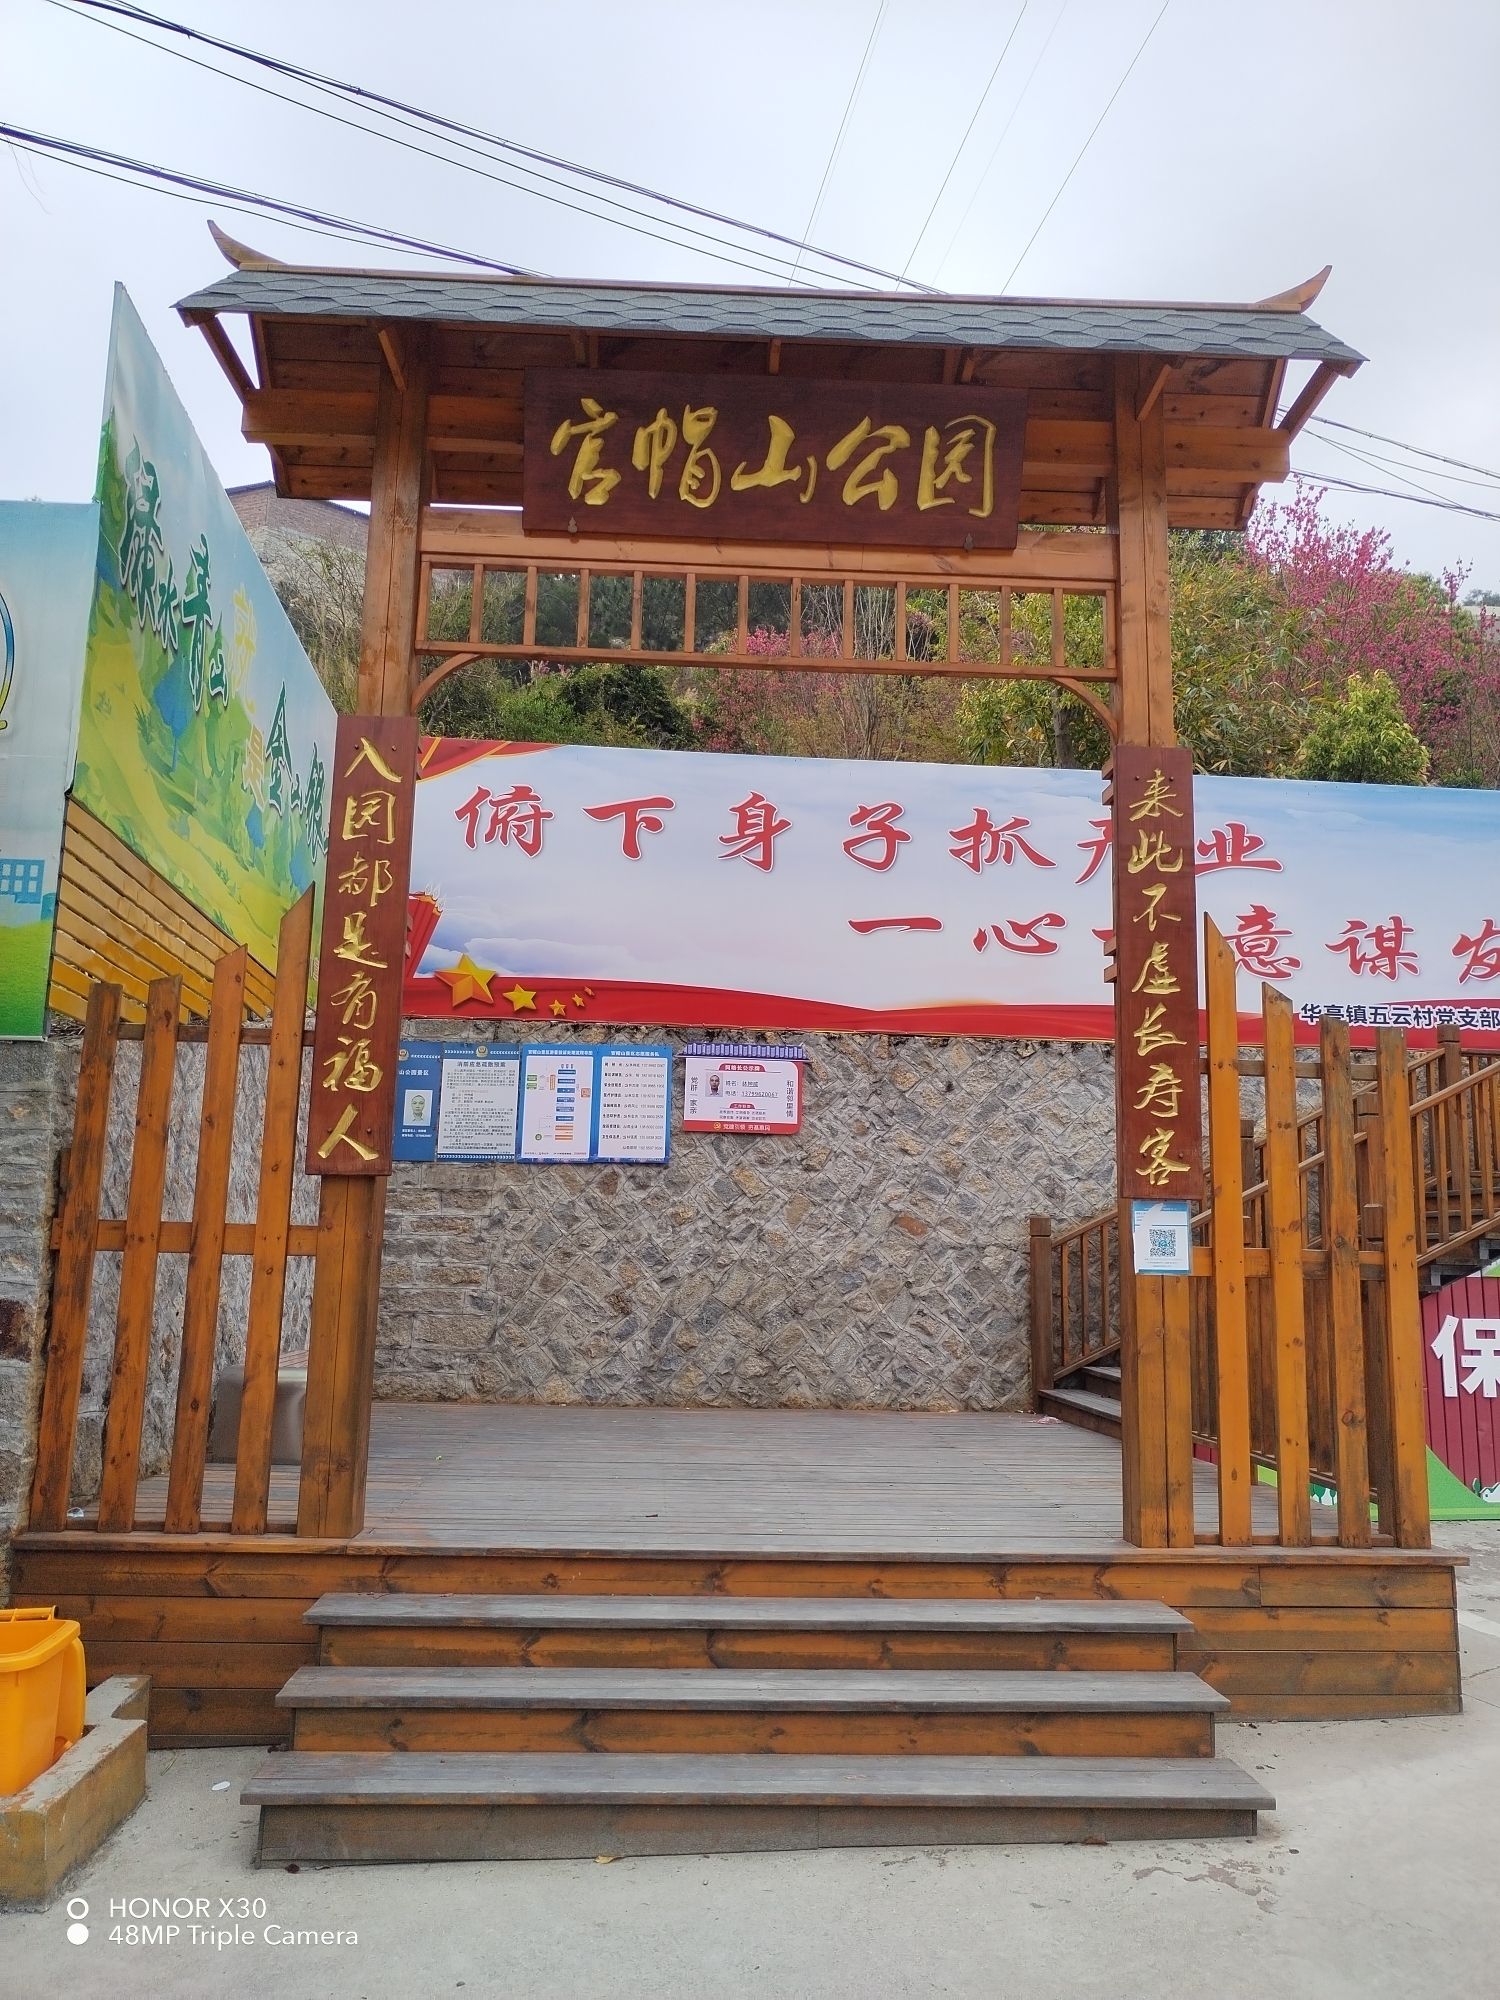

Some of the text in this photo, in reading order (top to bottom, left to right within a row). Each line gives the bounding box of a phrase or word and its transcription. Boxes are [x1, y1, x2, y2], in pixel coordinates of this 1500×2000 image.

[550, 398, 997, 518] 官帽山公园
[317, 736, 403, 1161] 入园都是有福人
[1127, 769, 1191, 1186] 来此不虚长寿客
[1430, 1314, 1500, 1398] 保
